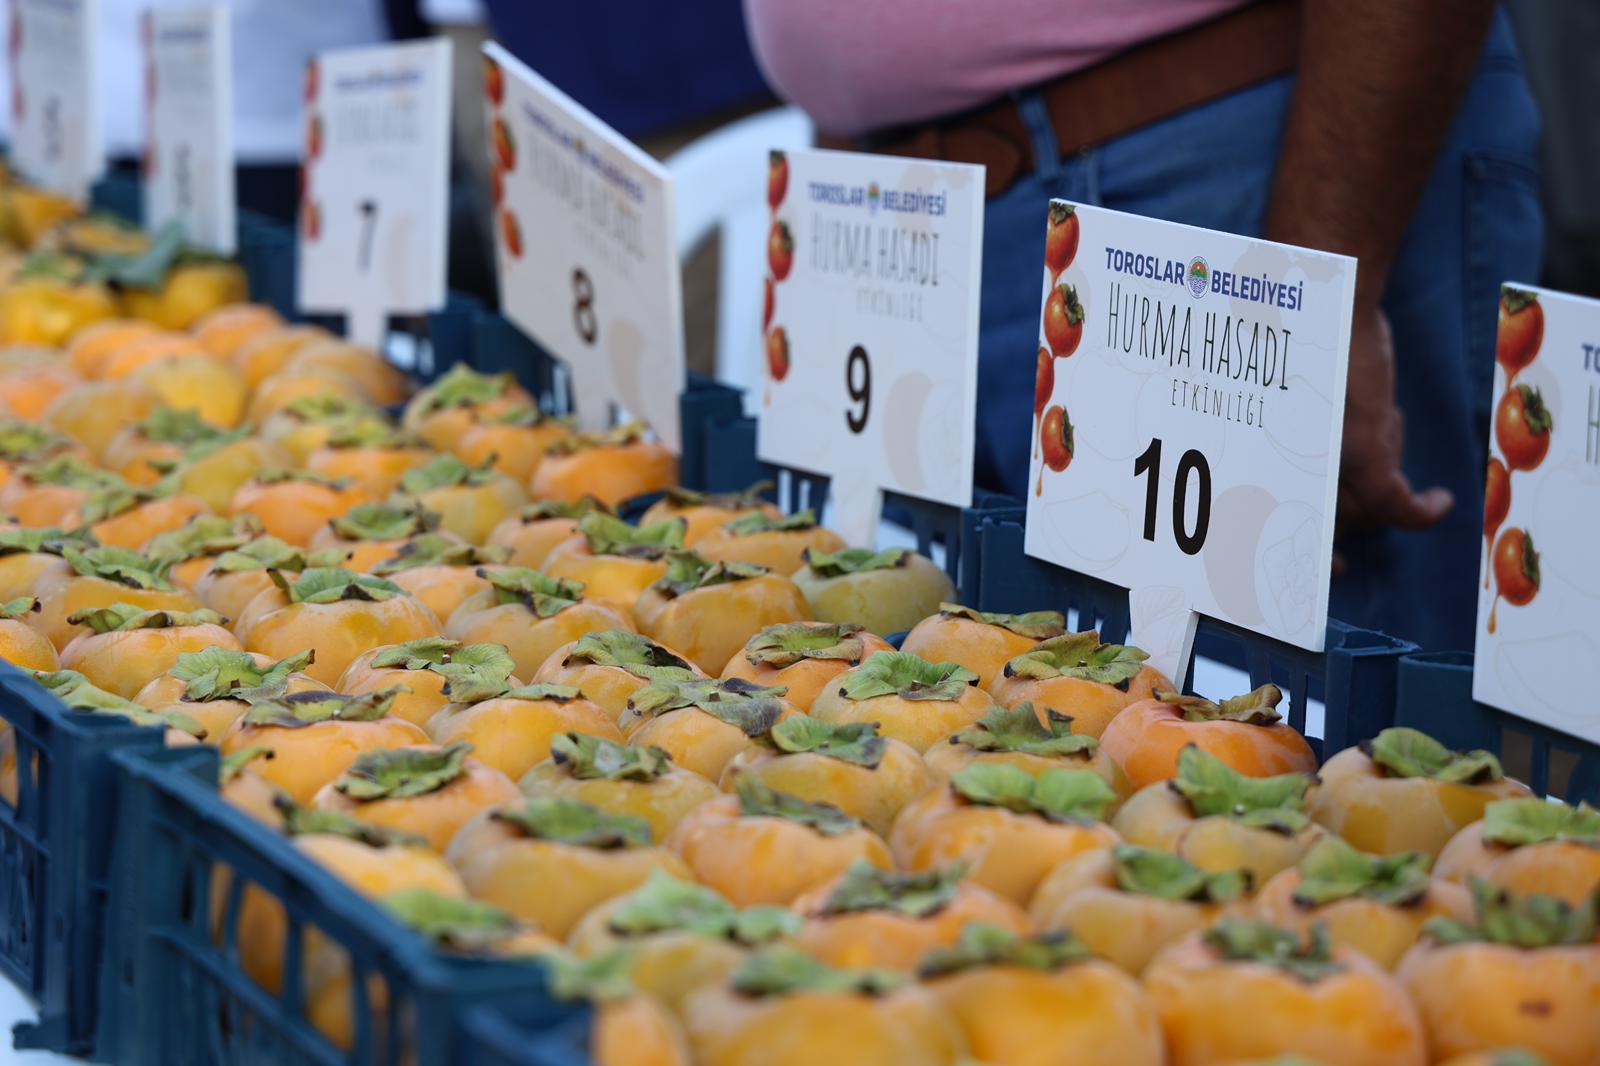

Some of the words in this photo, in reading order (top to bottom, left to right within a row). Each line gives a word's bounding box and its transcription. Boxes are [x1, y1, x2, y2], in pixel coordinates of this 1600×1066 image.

[357, 199, 378, 272] 7
[571, 266, 598, 346] 8
[1105, 247, 1186, 287] TOROSLAR
[1211, 269, 1304, 312] BELEDİYESİ
[1107, 281, 1192, 369] HURMA
[1202, 311, 1292, 391] HASADI
[845, 344, 872, 434] 9
[1170, 378, 1265, 429] ETKİNLİĞİ
[1133, 436, 1212, 557] 10
